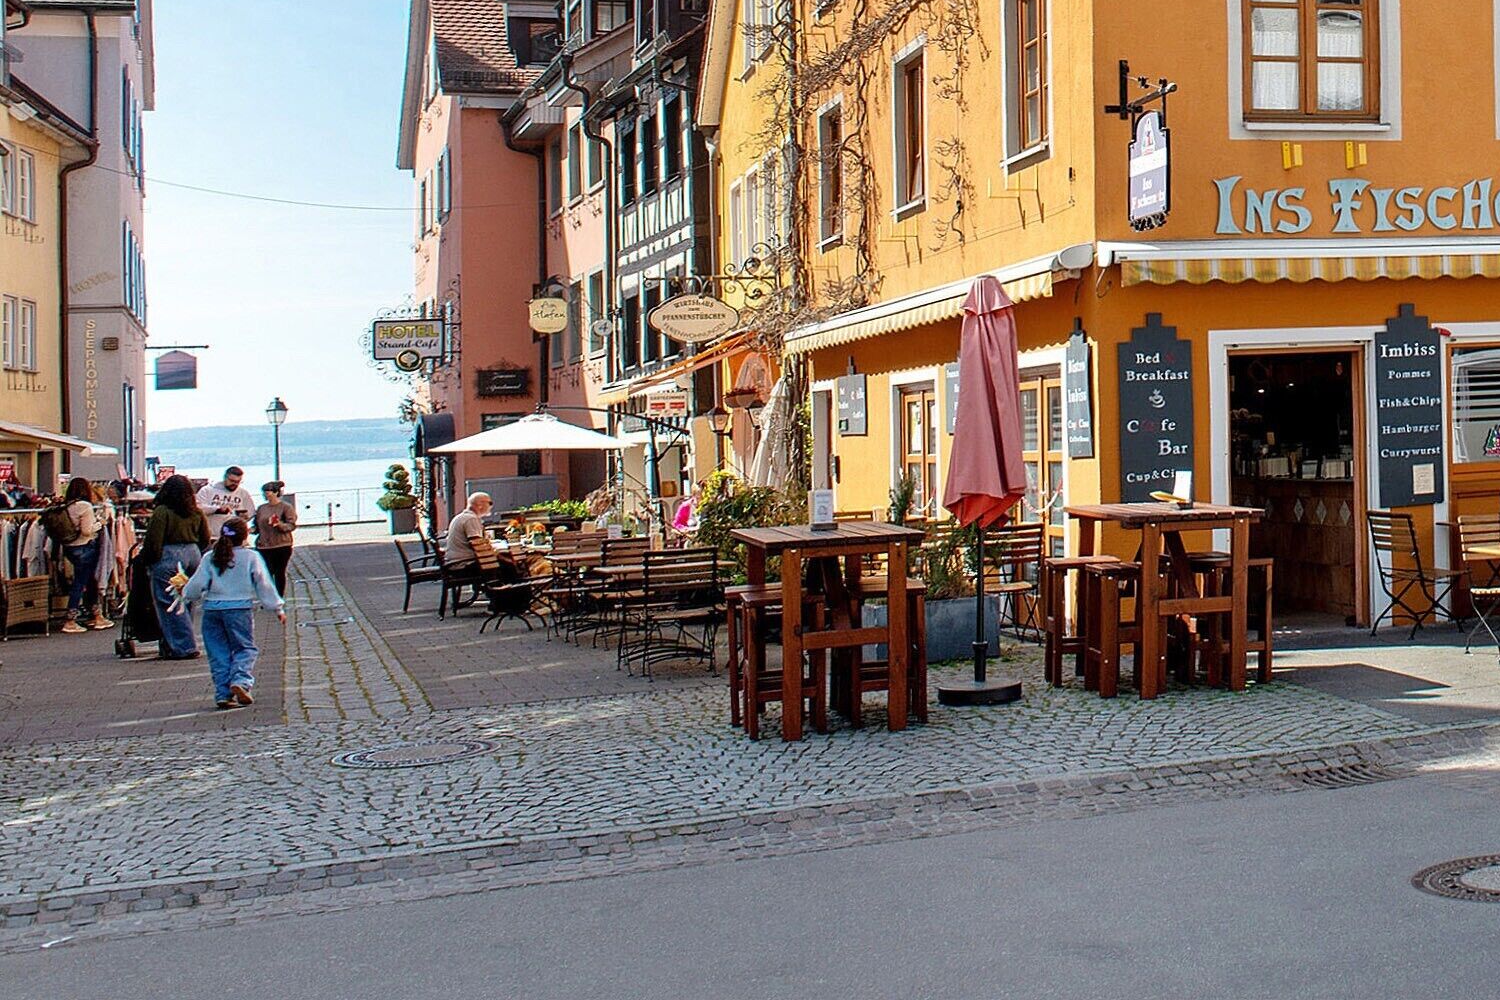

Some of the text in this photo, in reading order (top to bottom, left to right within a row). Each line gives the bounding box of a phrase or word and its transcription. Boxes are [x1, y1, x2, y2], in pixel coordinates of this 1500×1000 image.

[533, 309, 565, 320] Hafen
[379, 324, 439, 339] HOTEL
[1380, 342, 1436, 358] Imbiss
[1135, 352, 1160, 364] Bed
[85, 319, 98, 440] SEEPROMENADE
[1125, 369, 1189, 382] Breakfast
[1387, 370, 1431, 379] Pommes
[1379, 396, 1441, 408] Fish&Chips
[1381, 424, 1440, 434] Hamburger
[1158, 439, 1188, 456] Bar
[1380, 446, 1441, 458] Currywurst
